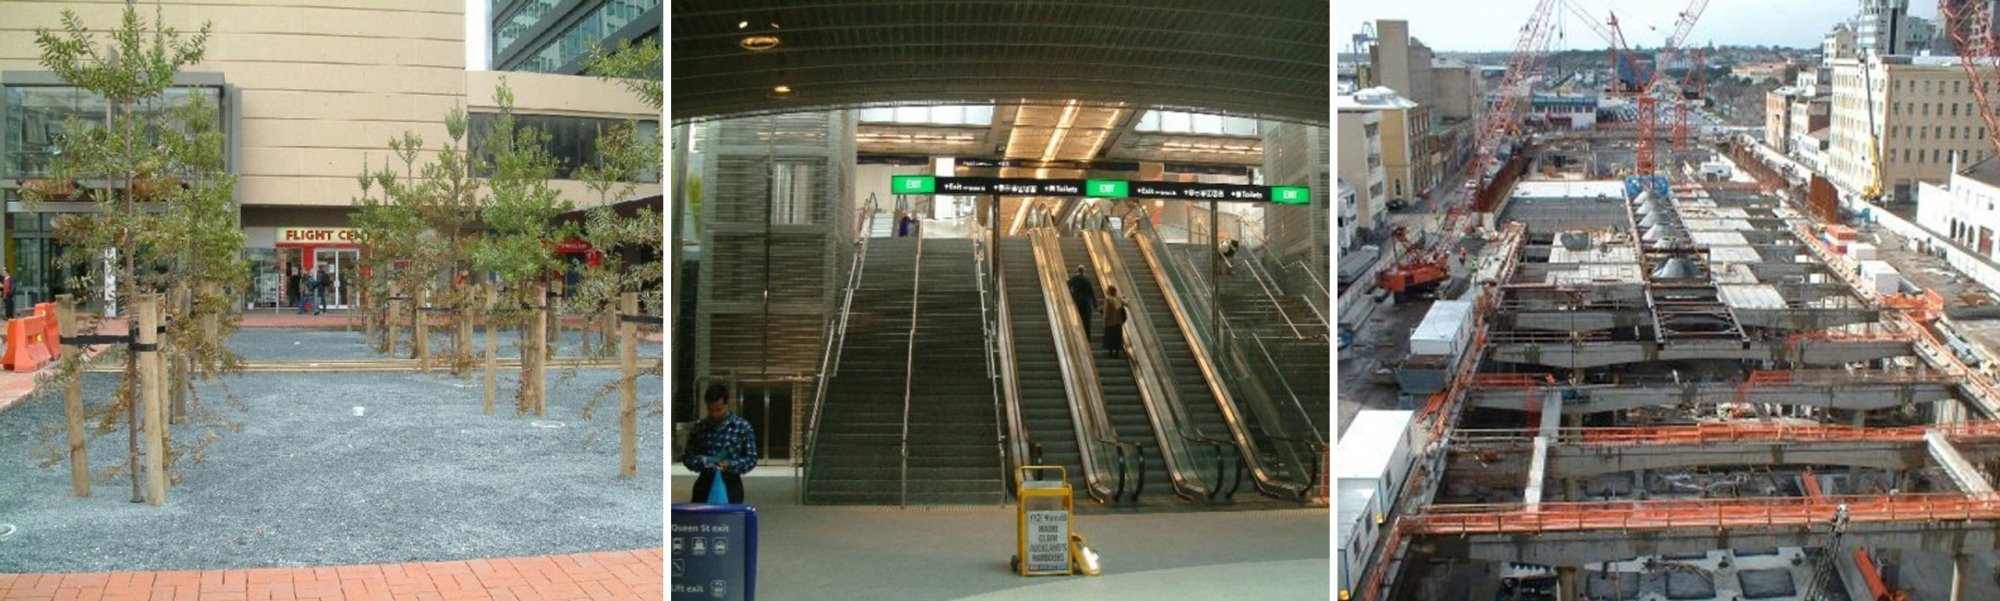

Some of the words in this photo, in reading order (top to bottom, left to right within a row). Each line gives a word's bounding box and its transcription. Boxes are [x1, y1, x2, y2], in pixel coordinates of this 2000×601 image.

[907, 180, 922, 189] EXIT
[1056, 185, 1077, 193] Toilets
[1100, 185, 1114, 193] EXIT
[1242, 191, 1263, 199] Toilets
[1284, 190, 1297, 199] EXIT
[286, 230, 334, 240] FLIGHT
[671, 524, 699, 532] Queen
[701, 524, 710, 532] St
[712, 524, 729, 532] exit
[1029, 543, 1067, 552] AUCKLAND'S
[1032, 552, 1065, 562] HARBOURS
[686, 584, 704, 592] exit
